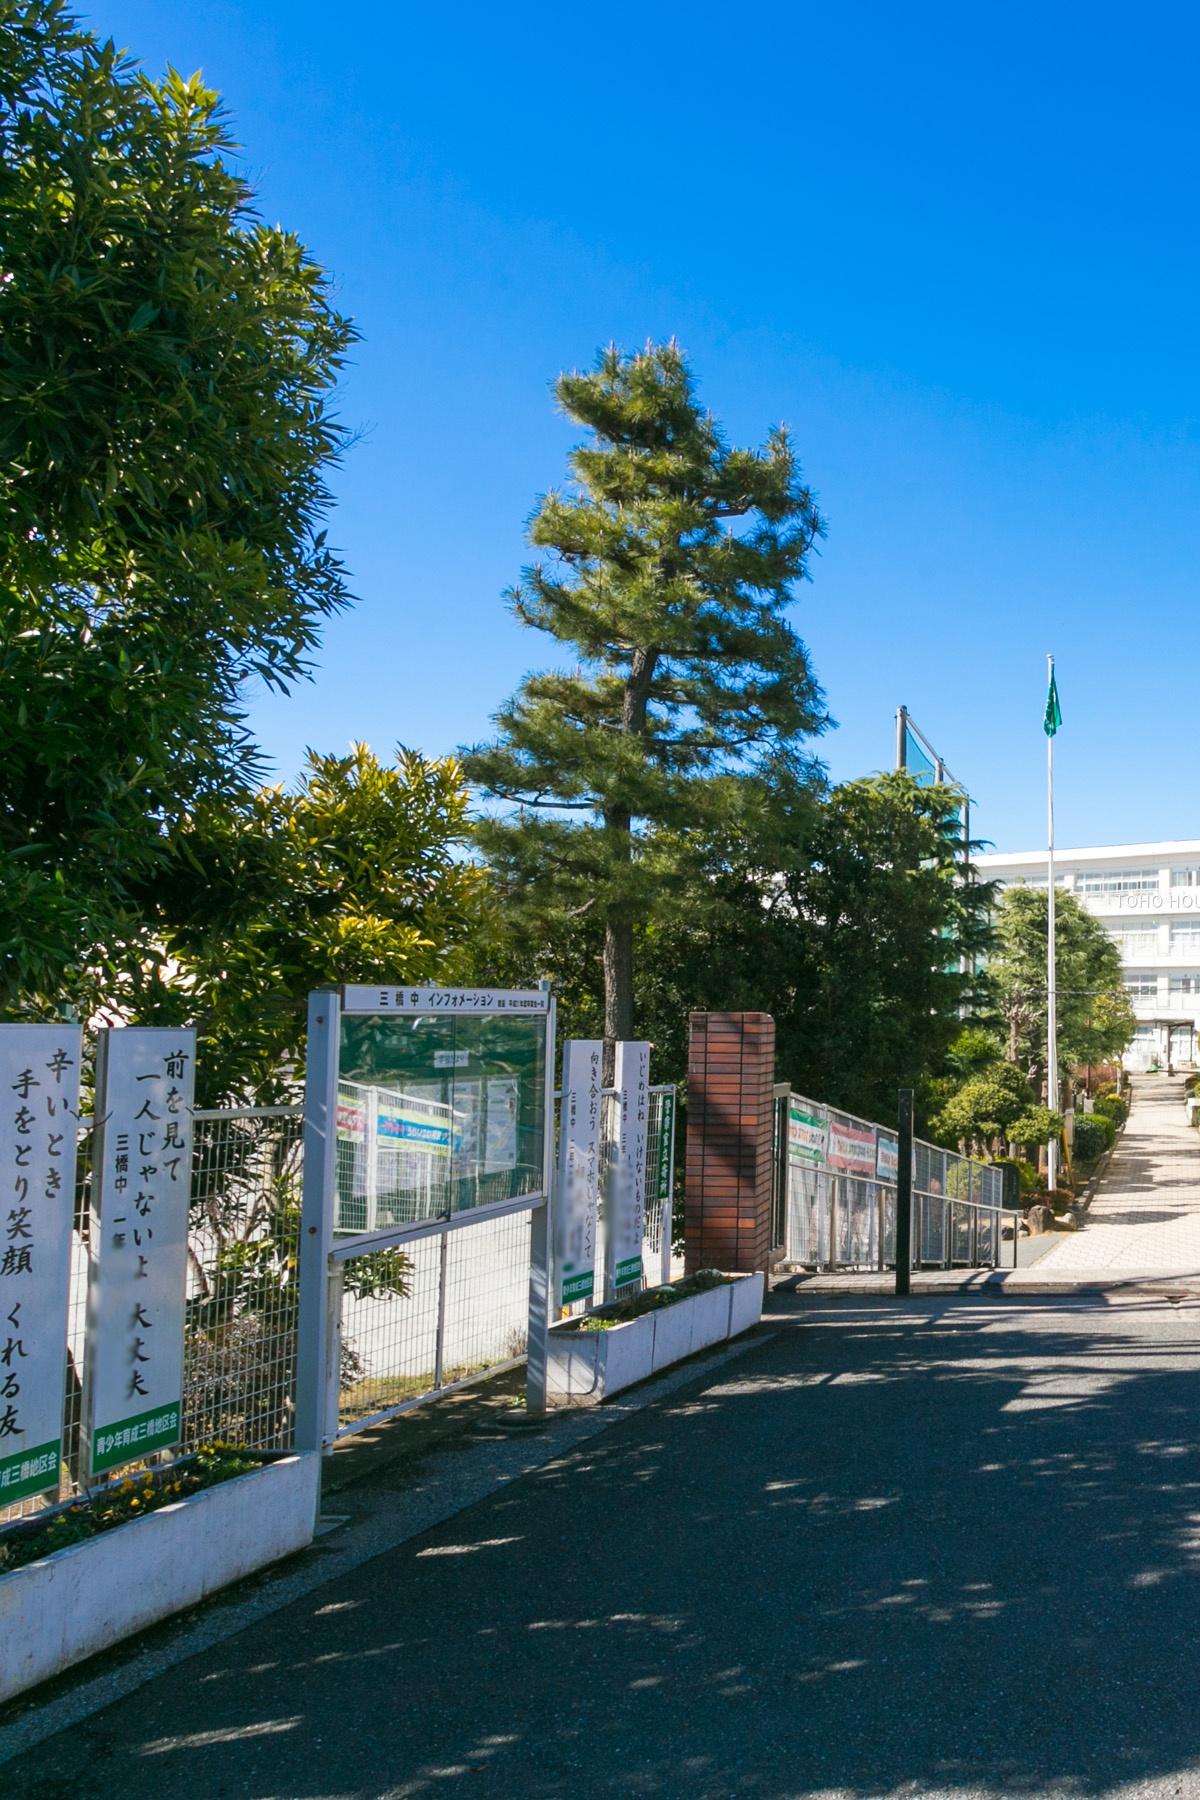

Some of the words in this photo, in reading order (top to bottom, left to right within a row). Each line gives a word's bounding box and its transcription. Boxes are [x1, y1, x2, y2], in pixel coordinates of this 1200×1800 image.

[379, 991, 419, 1007] 三橋中
[428, 992, 494, 1007] インフォメーション
[45, 1048, 74, 1199] 辛いとき
[161, 1049, 189, 1182] 前を見て
[588, 1051, 599, 1132] 向き合おう
[637, 1052, 647, 1122] いじめはね
[0, 1068, 41, 1277] 手をとり笑顔
[114, 1134, 129, 1194] 三橋中
[134, 1073, 161, 1279] 一人じゃないよ
[584, 1141, 596, 1258] スマホじゃなくて
[0, 1302, 29, 1438] くれる友
[0, 1451, 58, 1489] 成三橋地区会
[96, 1411, 178, 1457] 青少年育成三橋地区会
